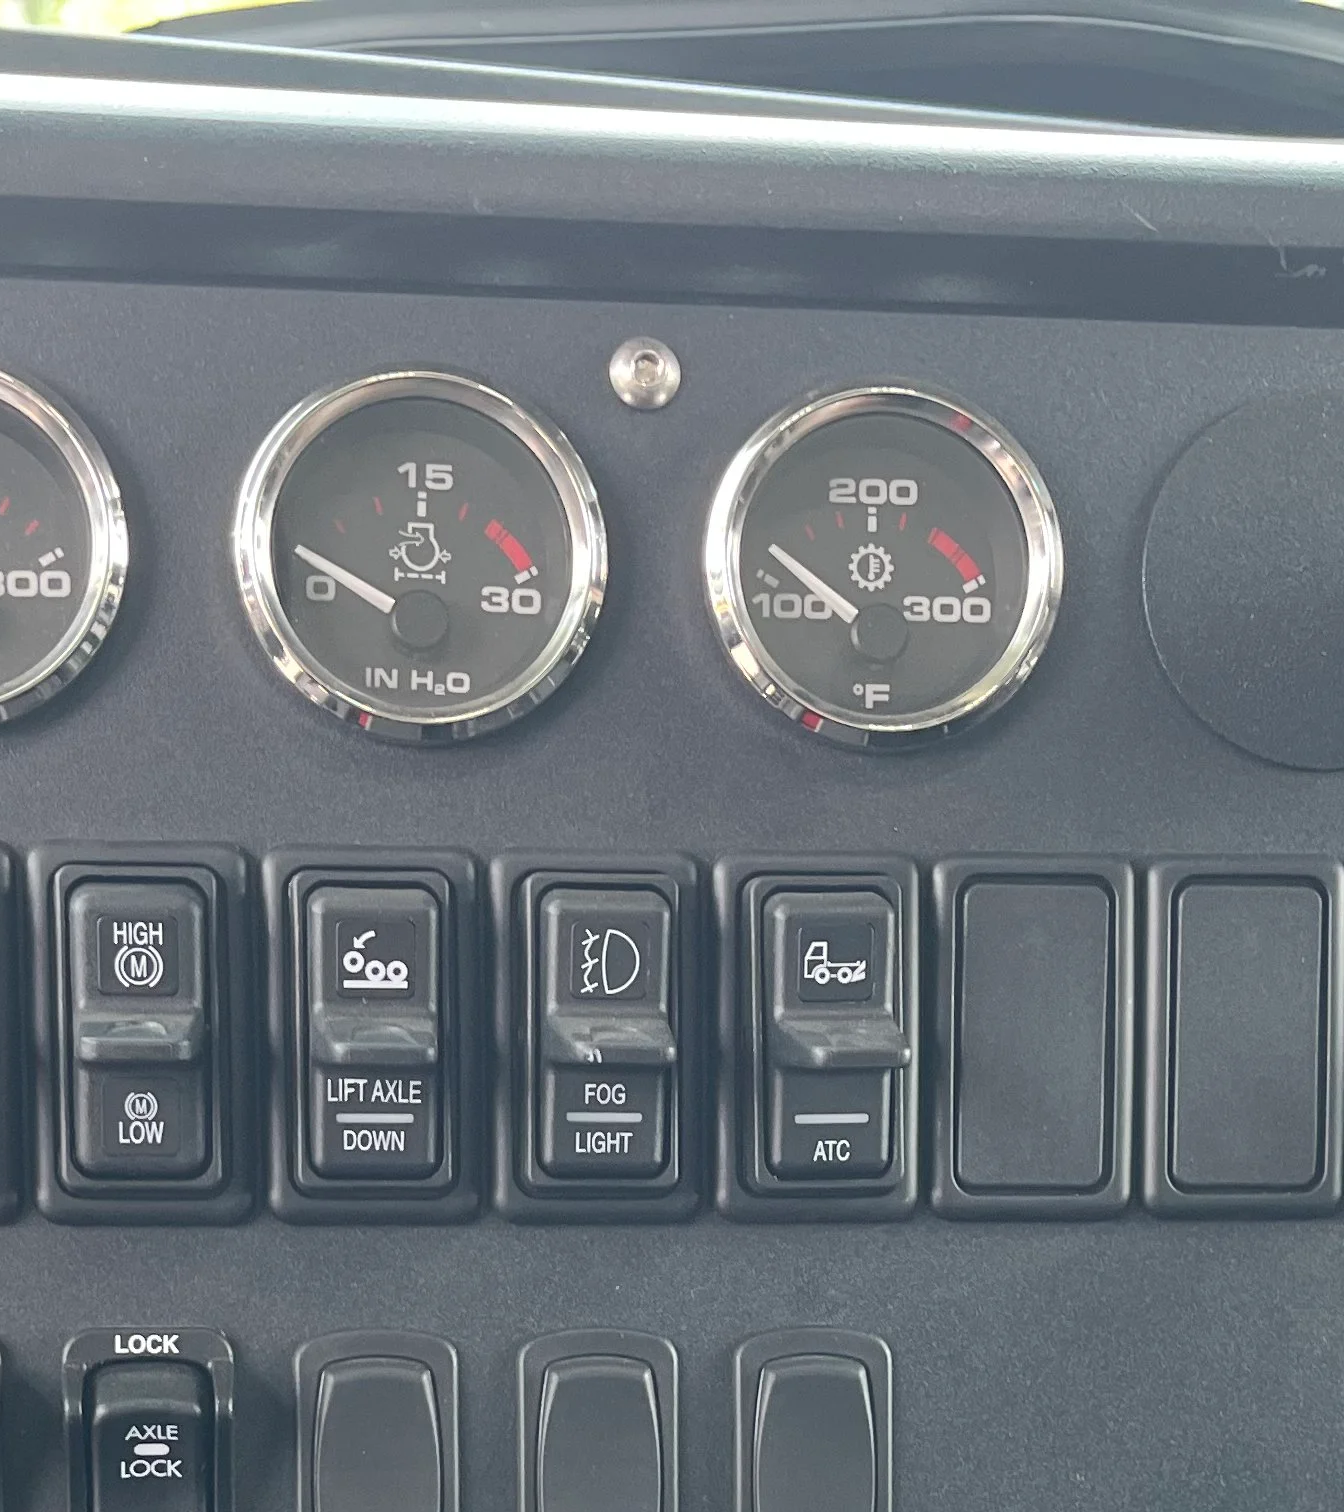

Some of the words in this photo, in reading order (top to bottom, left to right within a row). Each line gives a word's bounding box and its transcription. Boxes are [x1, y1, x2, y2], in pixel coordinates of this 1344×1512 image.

[397, 461, 454, 491] 15
[828, 477, 919, 506] 200
[305, 574, 337, 602] 0
[480, 585, 542, 616] 30
[752, 592, 834, 620] 100
[902, 595, 992, 623] 300
[365, 666, 398, 690] IN
[112, 921, 164, 945] HIGH
[326, 1078, 368, 1103] LIFT
[370, 1080, 423, 1104] AXLE
[584, 1083, 627, 1105] FOG
[118, 1121, 165, 1145] LOW
[342, 1129, 406, 1153] DOWN
[574, 1131, 634, 1155] LIGHT
[812, 1139, 852, 1162] ATC
[113, 1333, 180, 1355] LOCK
[124, 1424, 180, 1442] AXLE
[119, 1459, 183, 1479] LOCK
